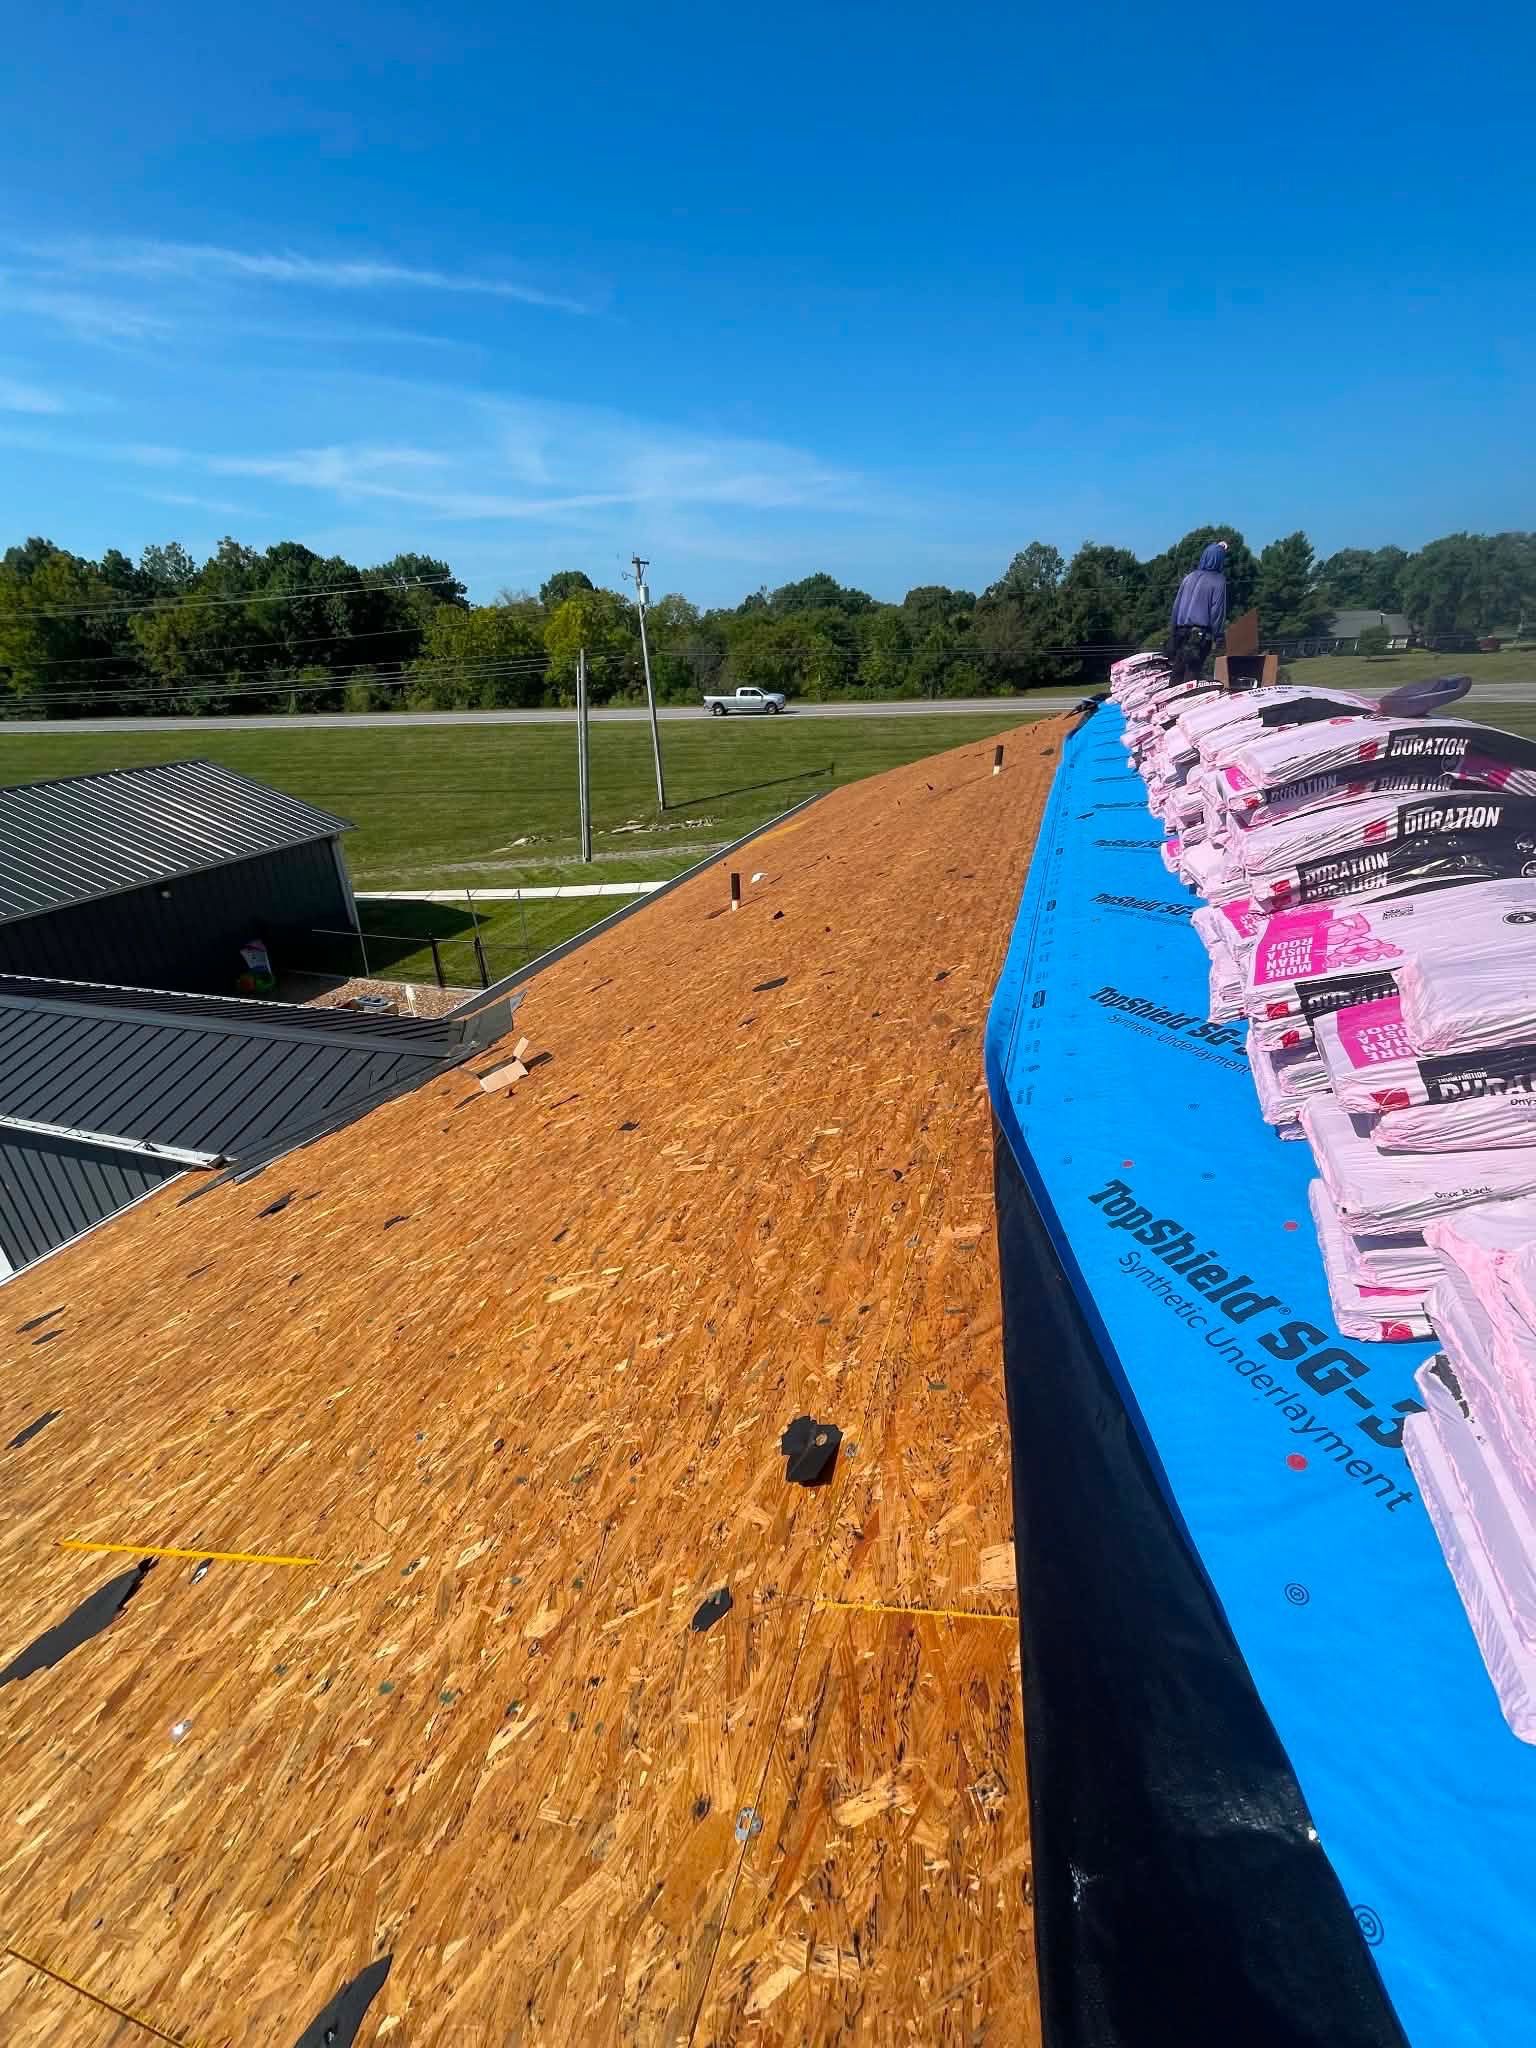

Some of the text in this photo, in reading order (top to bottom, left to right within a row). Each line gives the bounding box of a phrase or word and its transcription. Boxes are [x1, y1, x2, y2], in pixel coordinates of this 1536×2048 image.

[1391, 737, 1467, 757] DURATION
[1404, 807, 1500, 835] DURATION
[1266, 937, 1313, 952] ROOF
[1266, 944, 1312, 960] JUST A
[1265, 953, 1312, 970] THAN
[1265, 963, 1312, 979] MORE
[1089, 986, 1200, 1030] TopShield
[1107, 1013, 1158, 1037] Synthetic
[1354, 1022, 1409, 1039] OOF
[1375, 1029, 1409, 1042] UST
[1360, 1037, 1409, 1053] HAN
[1364, 1046, 1412, 1062] ORE
[1119, 1251, 1414, 1512] Synthetic Underlayment
[1256, 1321, 1427, 1469] SG-3
